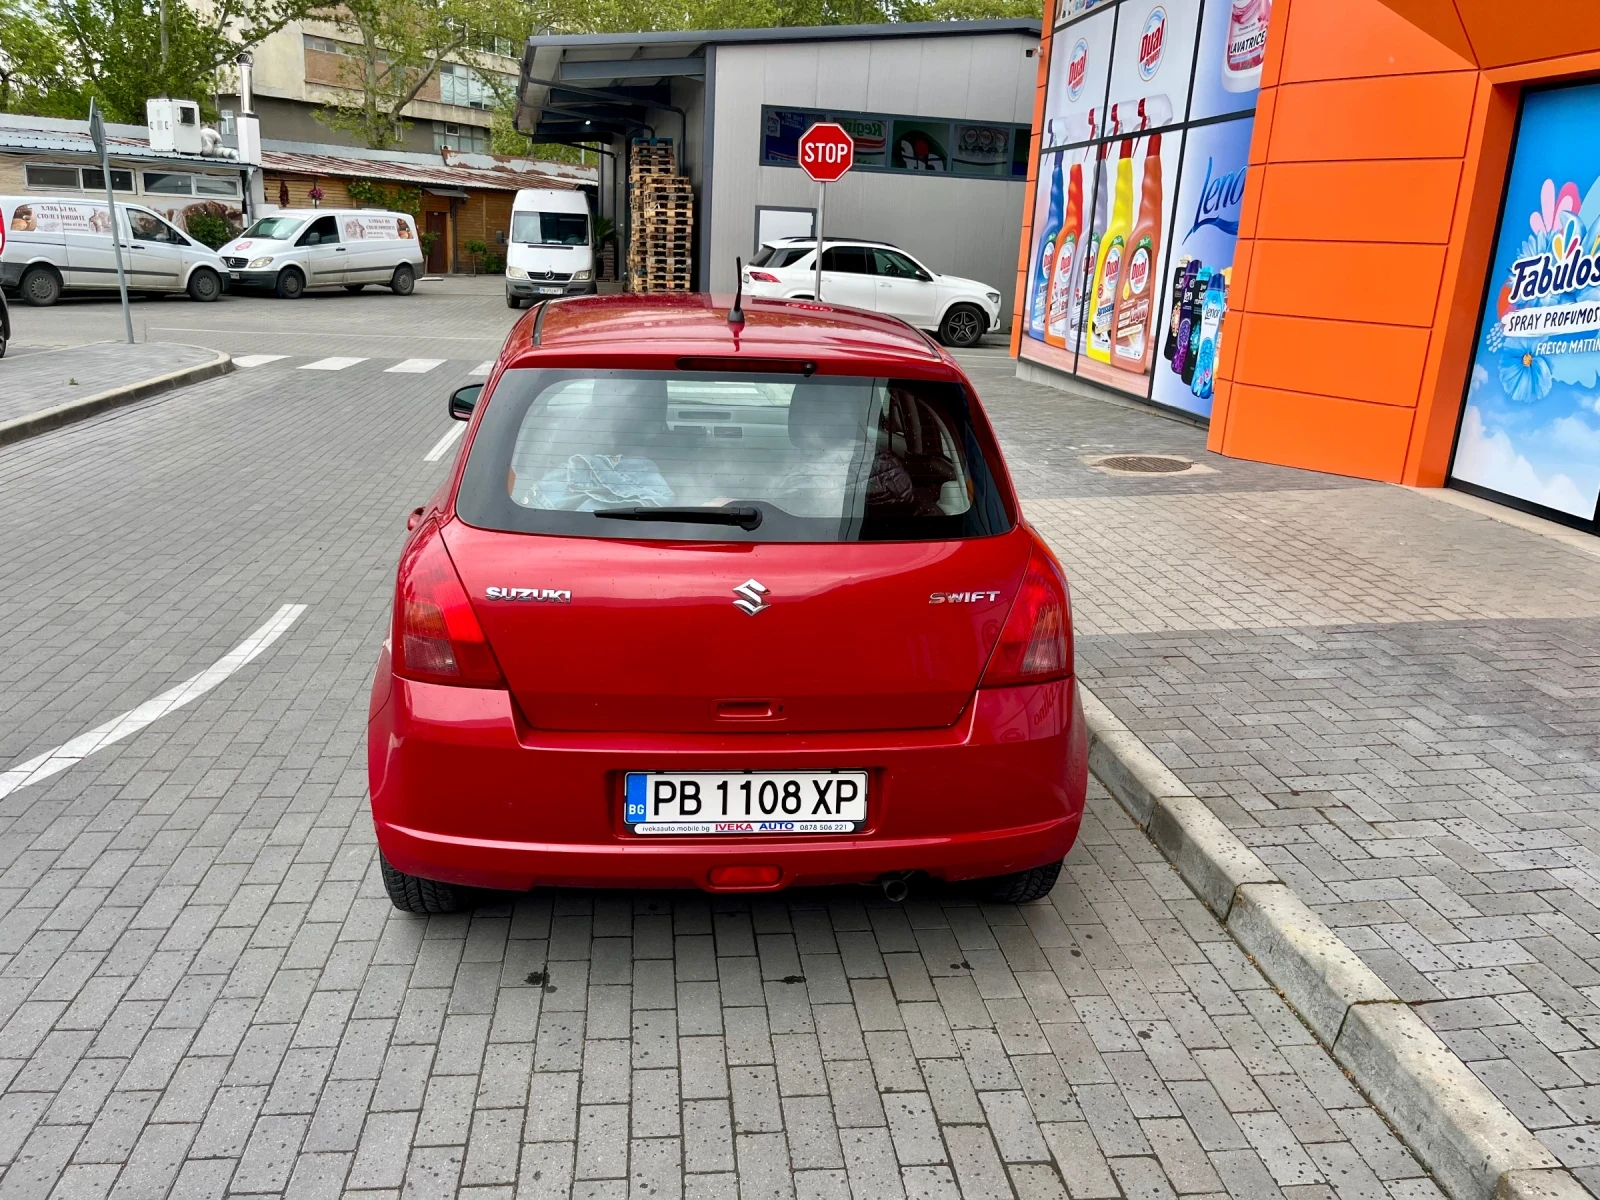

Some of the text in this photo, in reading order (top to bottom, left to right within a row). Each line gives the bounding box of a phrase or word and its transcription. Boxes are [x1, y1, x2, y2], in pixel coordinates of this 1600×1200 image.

[1140, 17, 1165, 63] Dual
[804, 142, 848, 163] STOP
[1191, 156, 1247, 230] Leno
[1508, 306, 1600, 332] SPRAY PROFUMOS
[1535, 340, 1567, 356] FRESCO
[485, 586, 572, 603] SUZUKI
[928, 590, 1001, 606] SWIFT
[653, 779, 858, 816] PB 1108 XP
[628, 804, 645, 815] BG
[715, 823, 754, 832] IVEKA
[758, 822, 795, 831] AUTO
[799, 824, 819, 832] 0878
[819, 824, 833, 832] 506
